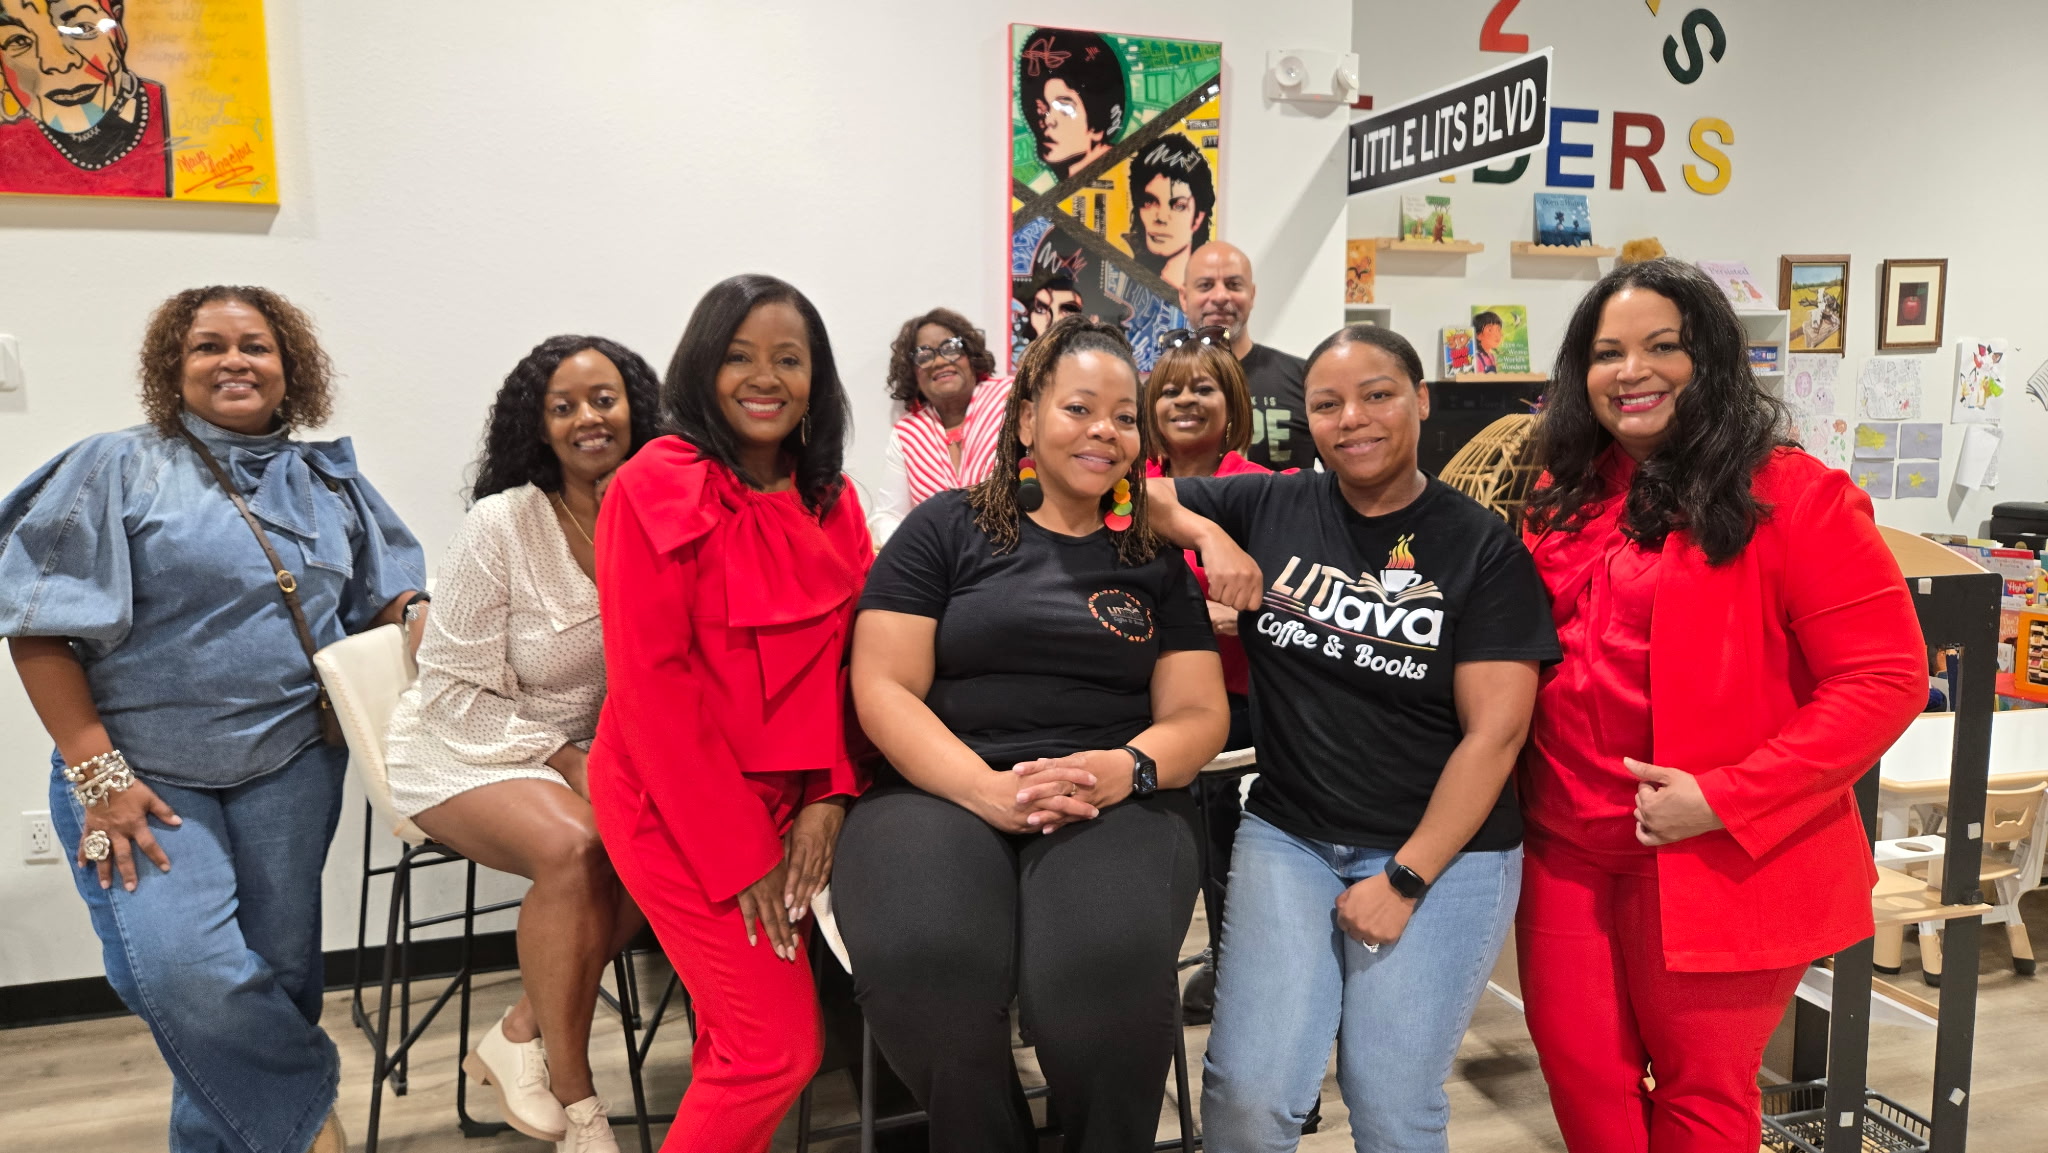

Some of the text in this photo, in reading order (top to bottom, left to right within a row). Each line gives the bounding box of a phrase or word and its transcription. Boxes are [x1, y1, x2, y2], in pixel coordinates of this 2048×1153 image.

[1350, 78, 1537, 182] LITTLE LITS BLVD
[1257, 612, 1428, 680] Coffee & Books
[1271, 556, 1444, 646] LIT Java
